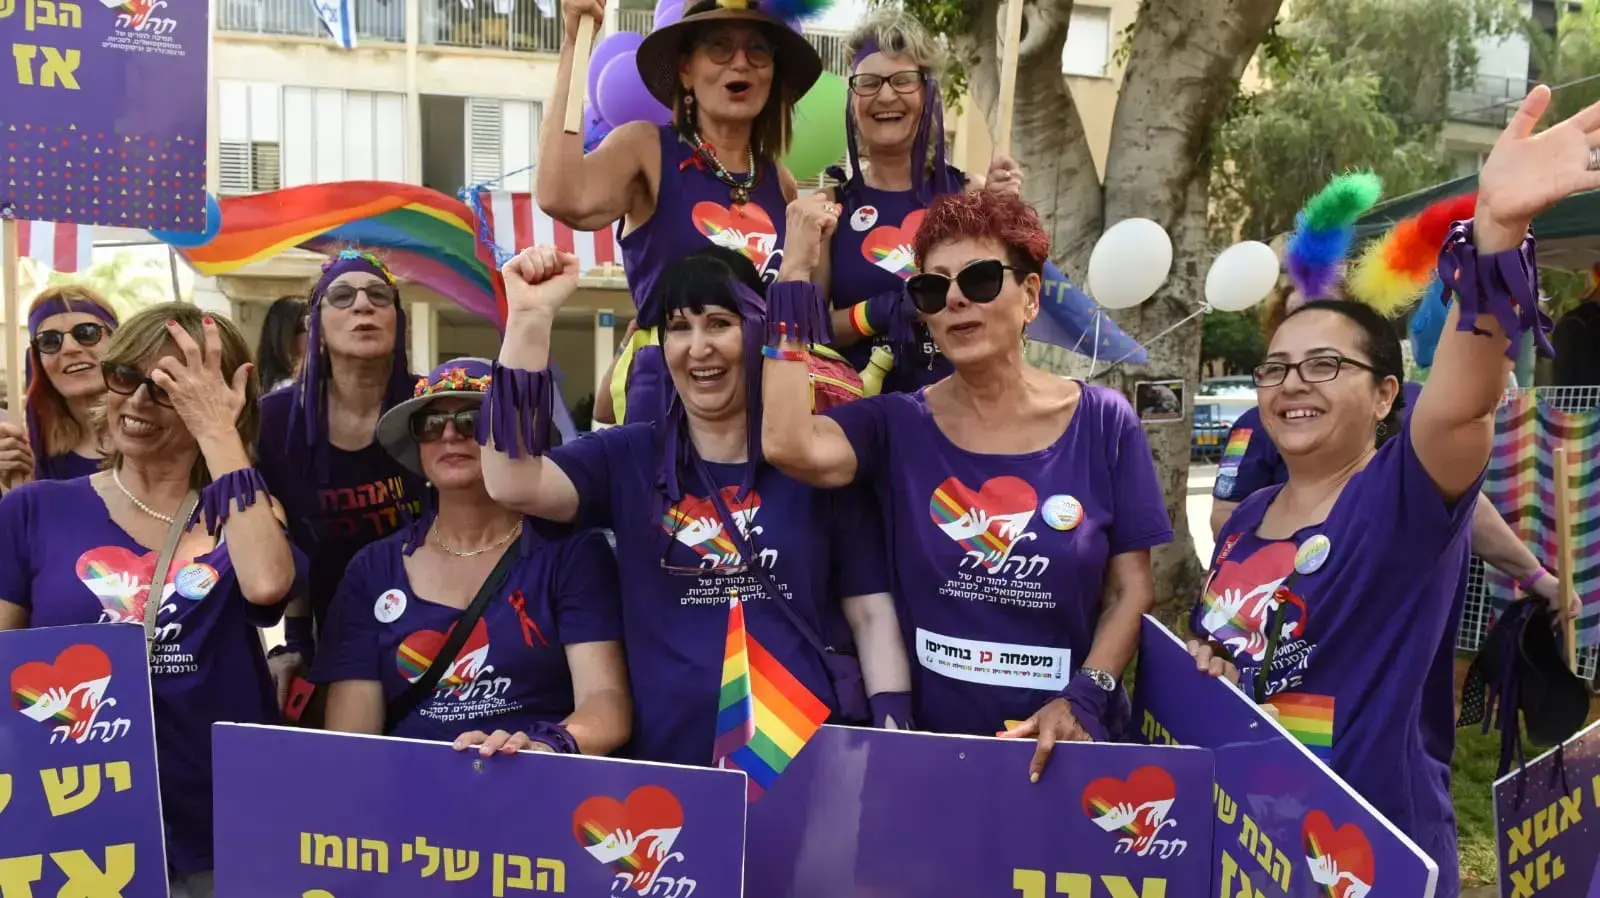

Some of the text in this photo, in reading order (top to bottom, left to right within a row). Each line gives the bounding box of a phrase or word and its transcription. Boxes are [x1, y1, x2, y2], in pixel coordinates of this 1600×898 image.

[25, 0, 82, 31] הבן
[12, 43, 81, 90] אז
[959, 532, 1050, 579] תהלייה
[698, 577, 713, 587] של
[715, 575, 745, 586] להורים
[938, 586, 996, 602] וביסקסואלים
[958, 571, 1041, 590] תמיכה להורים של
[154, 643, 181, 653] תמיכ
[979, 650, 993, 665] כן
[999, 652, 1054, 668] משפחה
[50, 697, 132, 745] תהלייה
[39, 760, 132, 818] יש
[1113, 818, 1188, 860] תהלייה
[1506, 786, 1583, 865] אמא
[300, 831, 566, 898] הבן שלי הומו
[1238, 813, 1292, 893] הבת
[611, 851, 697, 898] תהלייה
